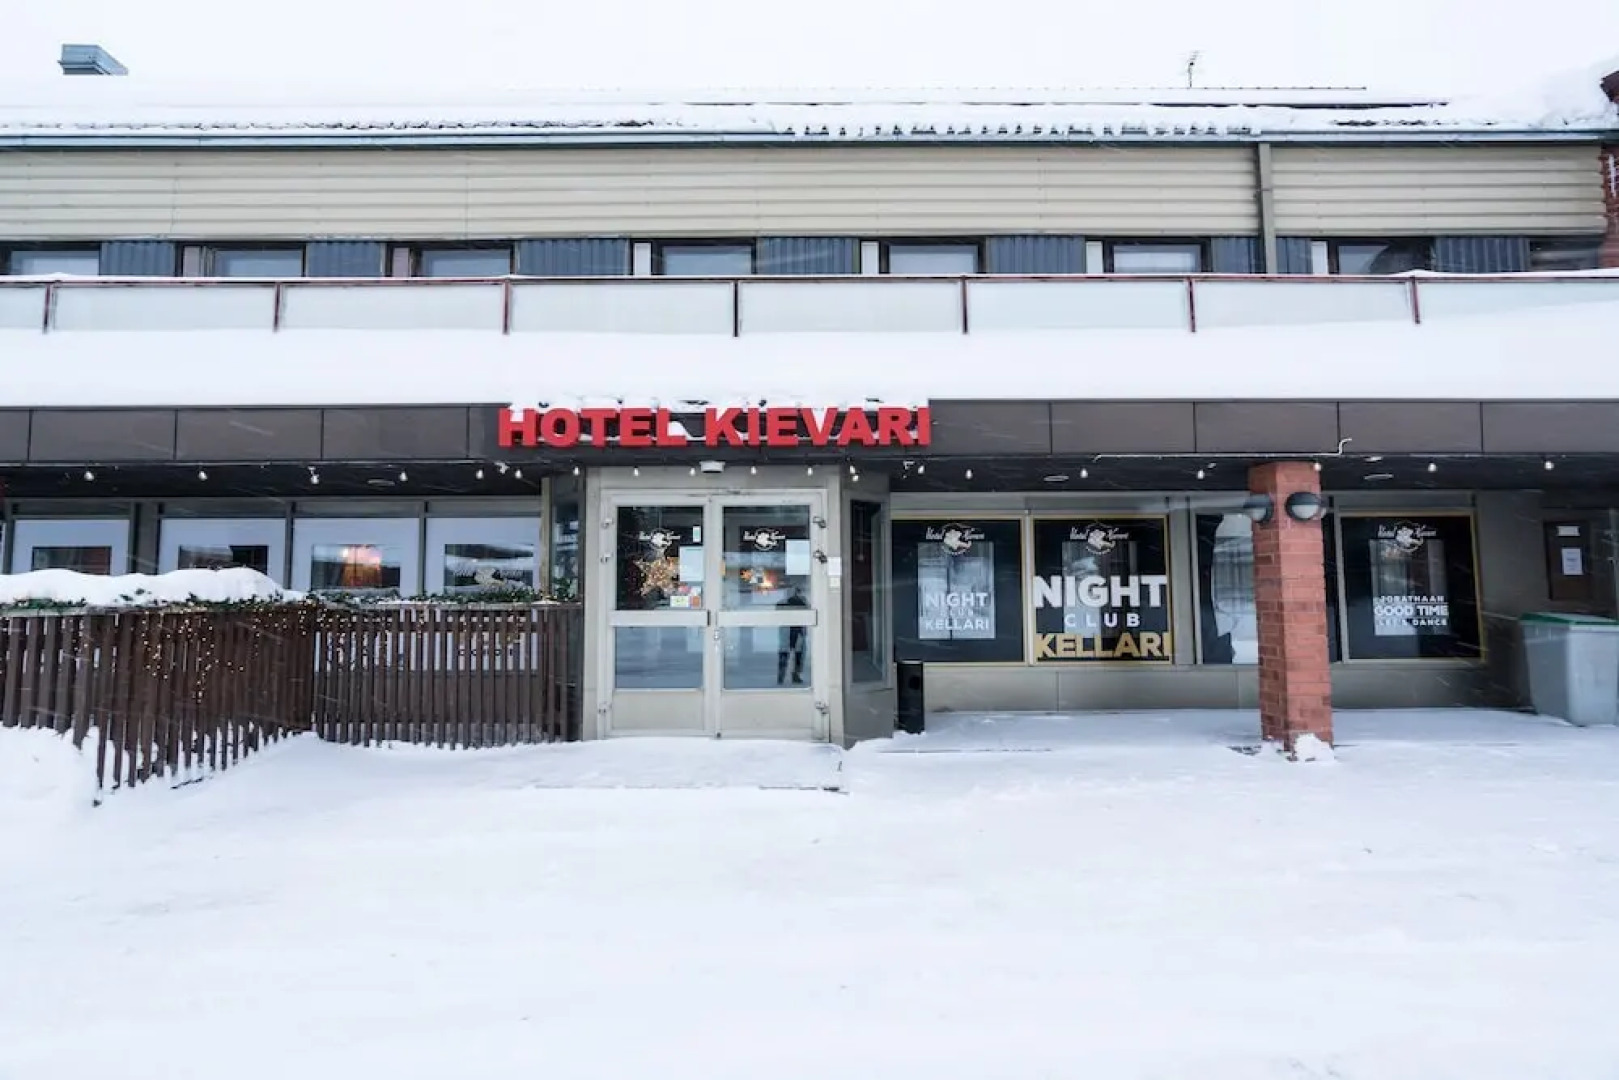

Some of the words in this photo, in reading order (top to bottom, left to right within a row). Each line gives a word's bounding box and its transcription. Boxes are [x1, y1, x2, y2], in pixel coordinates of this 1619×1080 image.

[498, 408, 687, 448] HOTEL
[704, 407, 931, 448] KIEVARI
[1033, 576, 1167, 608] NIGHT
[926, 592, 988, 607] NIGHT
[1374, 604, 1413, 616] GOOD
[1417, 604, 1449, 615] TIME
[925, 618, 989, 631] KELLARI
[1064, 613, 1140, 627] CLUB
[1413, 618, 1447, 626] DANCE
[1036, 632, 1172, 658] KELLARI
